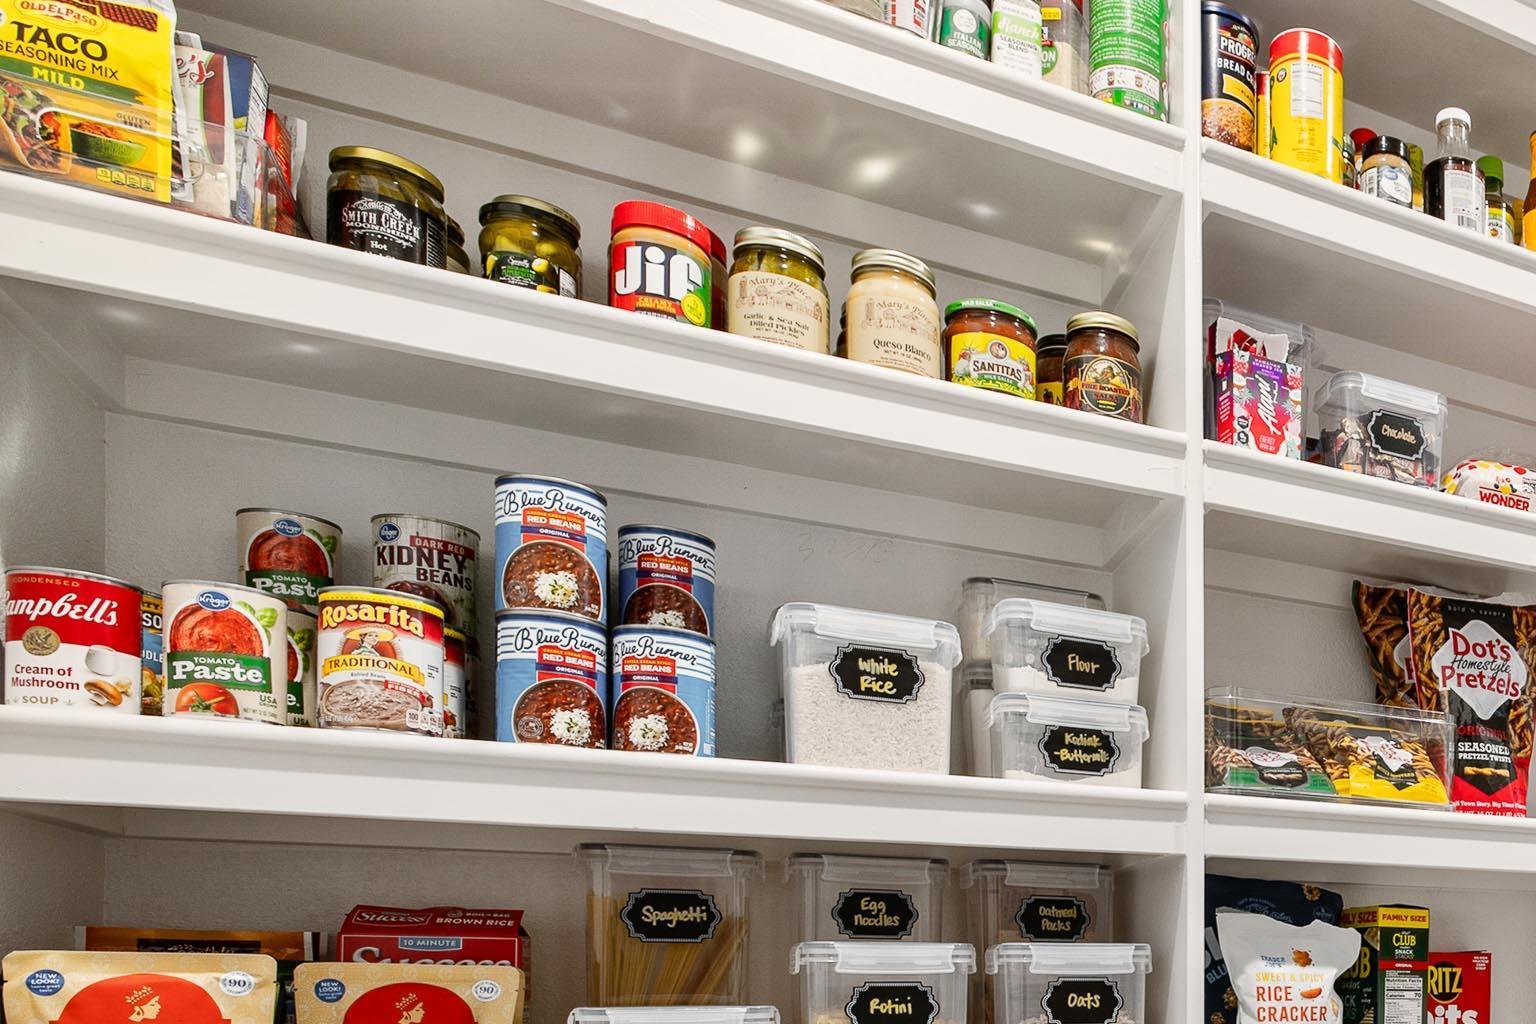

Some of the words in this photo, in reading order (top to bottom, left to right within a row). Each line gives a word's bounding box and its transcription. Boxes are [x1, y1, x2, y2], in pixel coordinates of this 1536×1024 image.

[11, 21, 108, 62] TACO
[953, 32, 982, 49] ITALIAN
[1220, 37, 1256, 62] PROGR
[0, 37, 86, 72] SEASONING
[91, 63, 119, 81] MIX
[1217, 58, 1245, 76] BREAD
[32, 66, 85, 90] MILD
[116, 112, 151, 126] GLUTEN
[341, 207, 377, 224] SMITH
[380, 213, 420, 237] CREEK
[370, 240, 387, 251] Hot
[614, 246, 703, 300] Jif
[750, 277, 784, 286] Mary's
[750, 320, 773, 328] Dilled
[775, 324, 805, 336] Pickles
[873, 339, 902, 350] Queso
[905, 344, 931, 361] Blanco
[973, 360, 1022, 381] SANTITAS
[1081, 383, 1098, 391] FIRE
[1099, 384, 1130, 396] ROASTED
[1255, 374, 1281, 435] Alani
[1381, 424, 1416, 444] Chocolate
[504, 490, 546, 516] Blue
[545, 488, 602, 527] Runner
[1479, 490, 1530, 512] WONDER
[526, 515, 548, 524] RED
[550, 518, 582, 531] BEANS
[415, 539, 443, 550] DARK
[622, 542, 657, 561] Blue
[657, 536, 708, 568] Runner
[376, 545, 467, 574] KIDNEY
[662, 562, 688, 573] BEANS
[272, 575, 308, 583] TOMATO
[416, 568, 472, 591] BEANS
[321, 604, 425, 638] Rosarita
[515, 628, 562, 651] Blue
[1451, 630, 1512, 662] Dot's
[615, 639, 639, 663] Blue
[637, 636, 698, 666] Runner
[193, 656, 235, 665] TOMATO
[328, 659, 415, 676] TRADITIONAL
[542, 654, 562, 662] RED
[564, 657, 594, 668] BEANS
[624, 664, 640, 672] RED
[642, 664, 672, 673] BEANS
[858, 656, 899, 676] White
[1067, 654, 1099, 674] Flour
[1451, 655, 1512, 676] Homestyle
[15, 664, 54, 676] Cream
[58, 666, 72, 677] of
[172, 660, 266, 685] Paste
[556, 666, 584, 676] ORIGINAL
[632, 674, 659, 682] ORIGINAL
[12, 677, 80, 691] Mushroom
[860, 677, 896, 695] Rice
[1441, 665, 1519, 698] Pretzels
[22, 696, 59, 705] SOUP
[1458, 742, 1510, 755] SEASONED
[860, 898, 886, 914] Egg
[356, 912, 427, 923] Success
[641, 906, 708, 928] Spaghetti
[1041, 918, 1071, 931] Packs
[1393, 934, 1416, 946] CLUB
[1256, 973, 1286, 982] SWEET
[1428, 966, 1462, 994] RITZ
[1067, 992, 1101, 1009] Oats
[1256, 986, 1293, 1001] RICE
[870, 997, 912, 1015] Rotini
[1257, 1006, 1327, 1022] CRACKER
